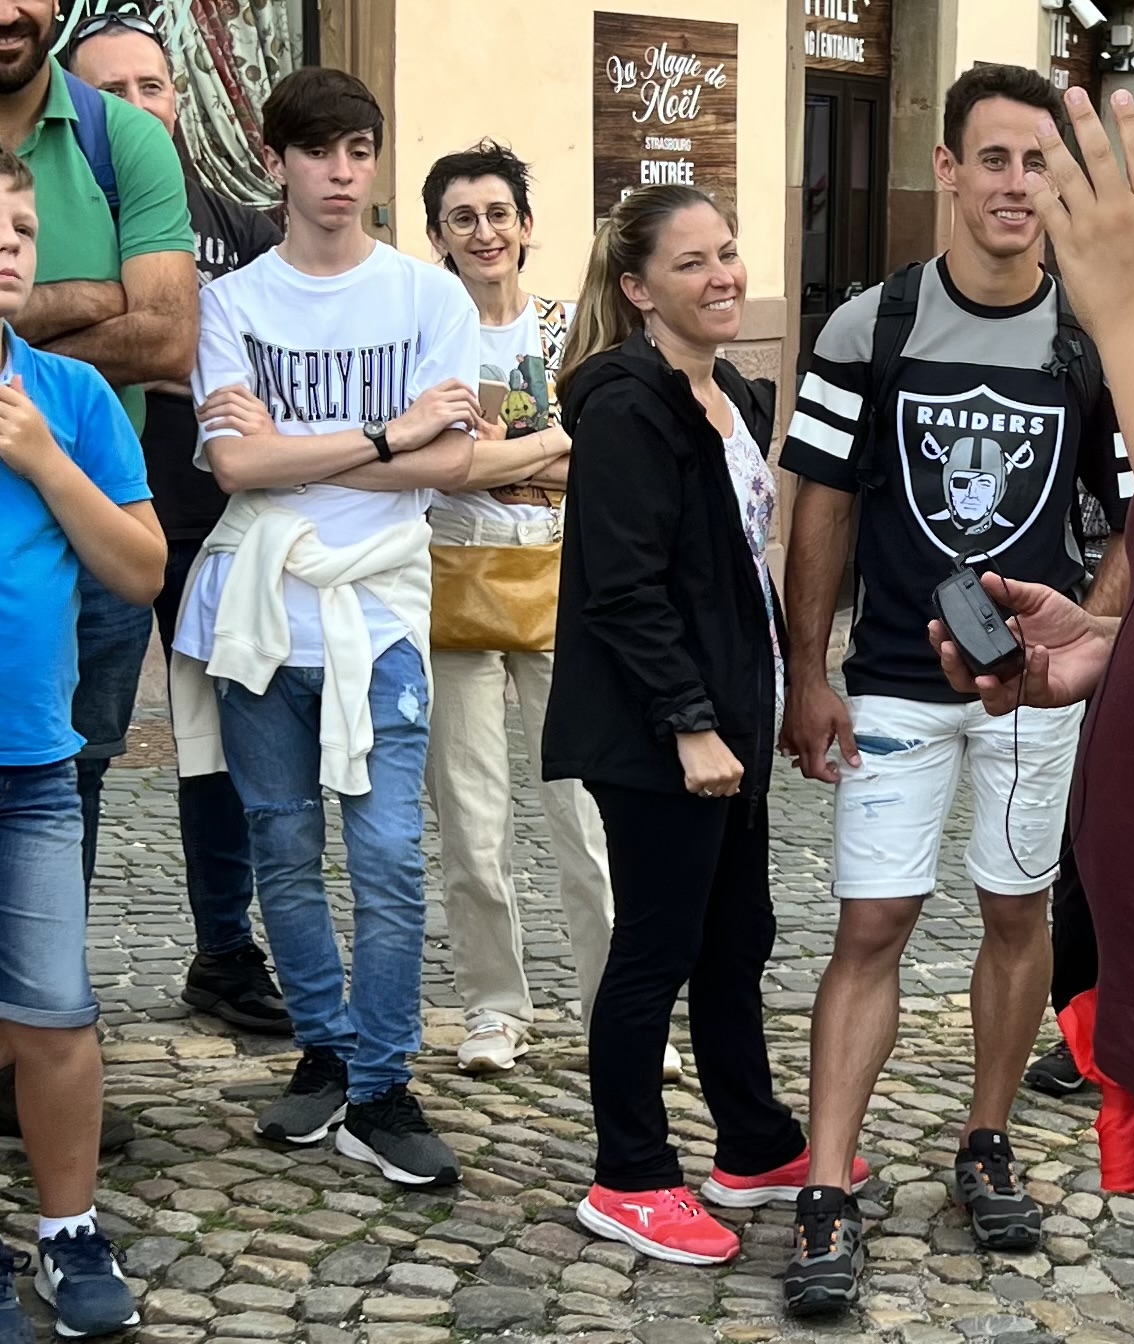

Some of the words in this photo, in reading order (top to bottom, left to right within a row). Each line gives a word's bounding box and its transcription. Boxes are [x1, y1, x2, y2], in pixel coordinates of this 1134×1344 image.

[606, 55, 637, 94] La
[640, 41, 702, 87] Magie
[704, 63, 727, 89] de
[632, 79, 702, 125] Noël
[640, 157, 695, 186] ENTRÉE
[916, 406, 1045, 435] RAIDERS
